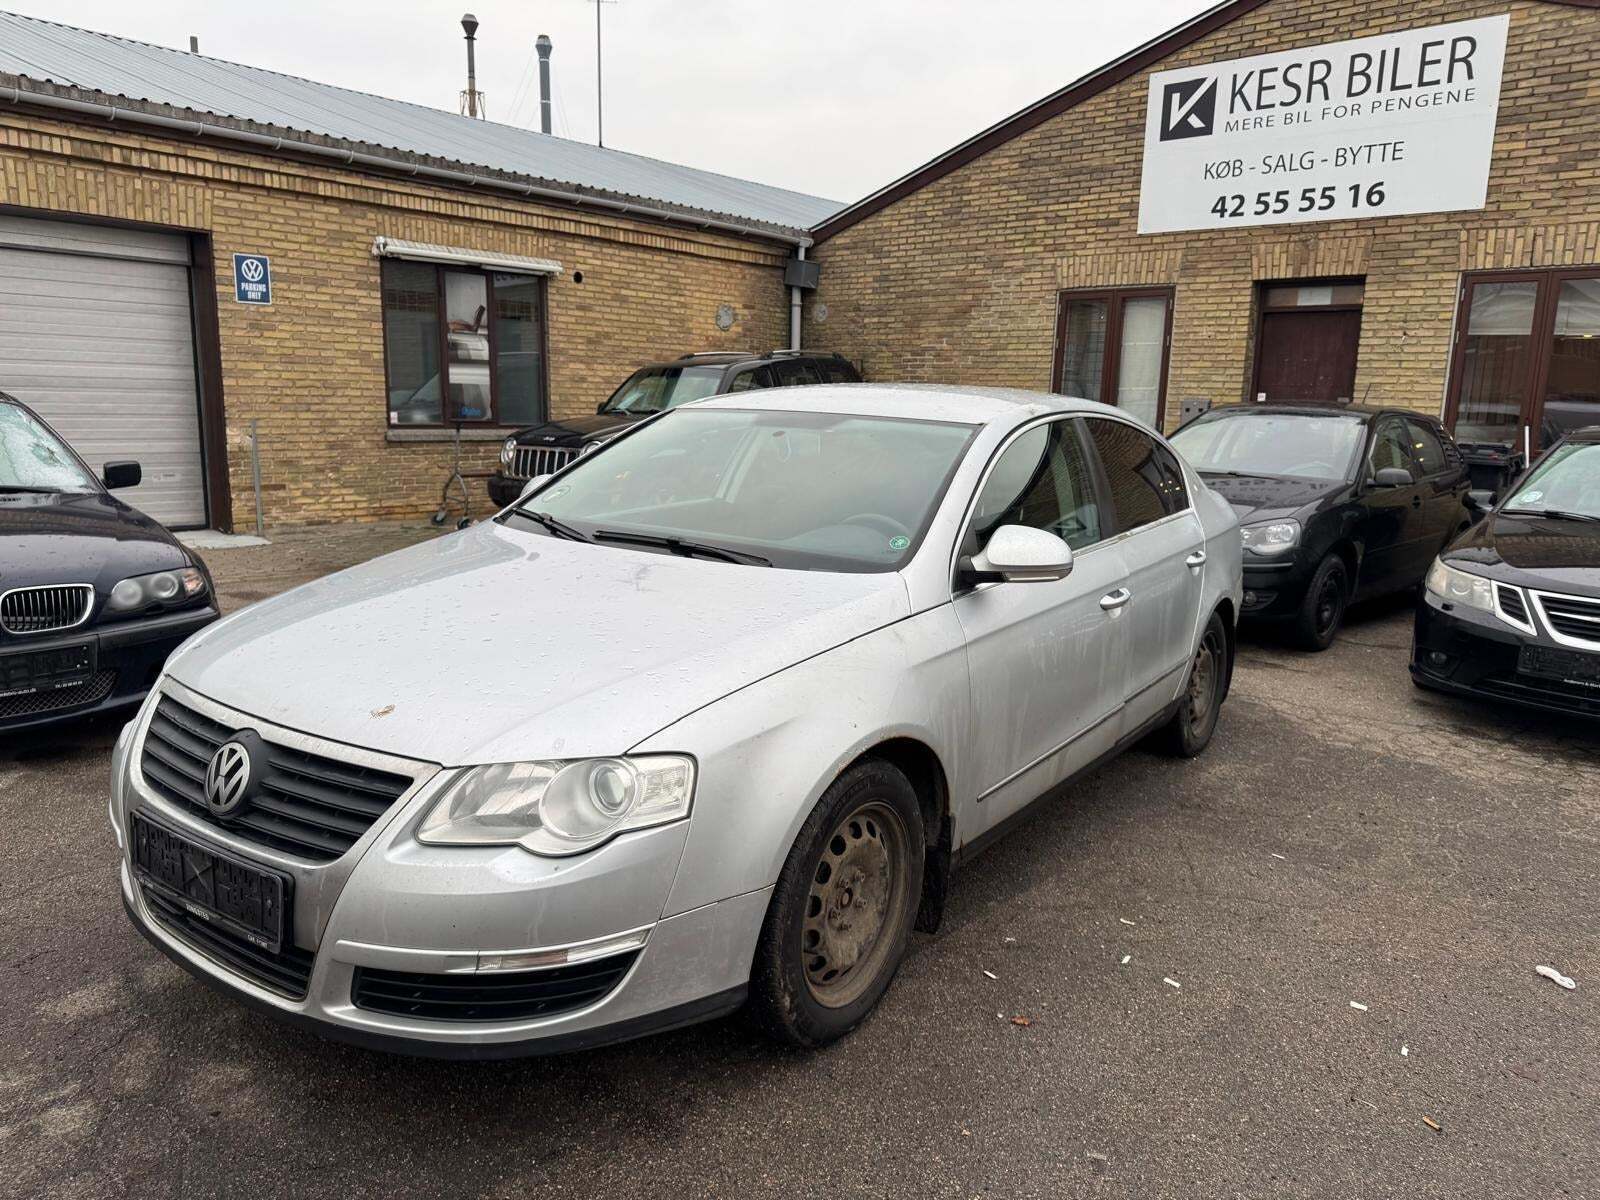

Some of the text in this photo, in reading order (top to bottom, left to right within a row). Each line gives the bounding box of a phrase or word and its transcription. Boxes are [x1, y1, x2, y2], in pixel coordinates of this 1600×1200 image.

[1229, 35, 1477, 115] KESR BILER
[1224, 87, 1476, 133] MERE BIL FOR PENGENE
[1204, 159, 1243, 180] KØB
[1261, 150, 1315, 176] SALG
[1334, 140, 1405, 167] BYTTE
[1210, 181, 1386, 219] 42 55 55 16
[241, 282, 266, 291] PARKING
[247, 291, 262, 300] ONLY
